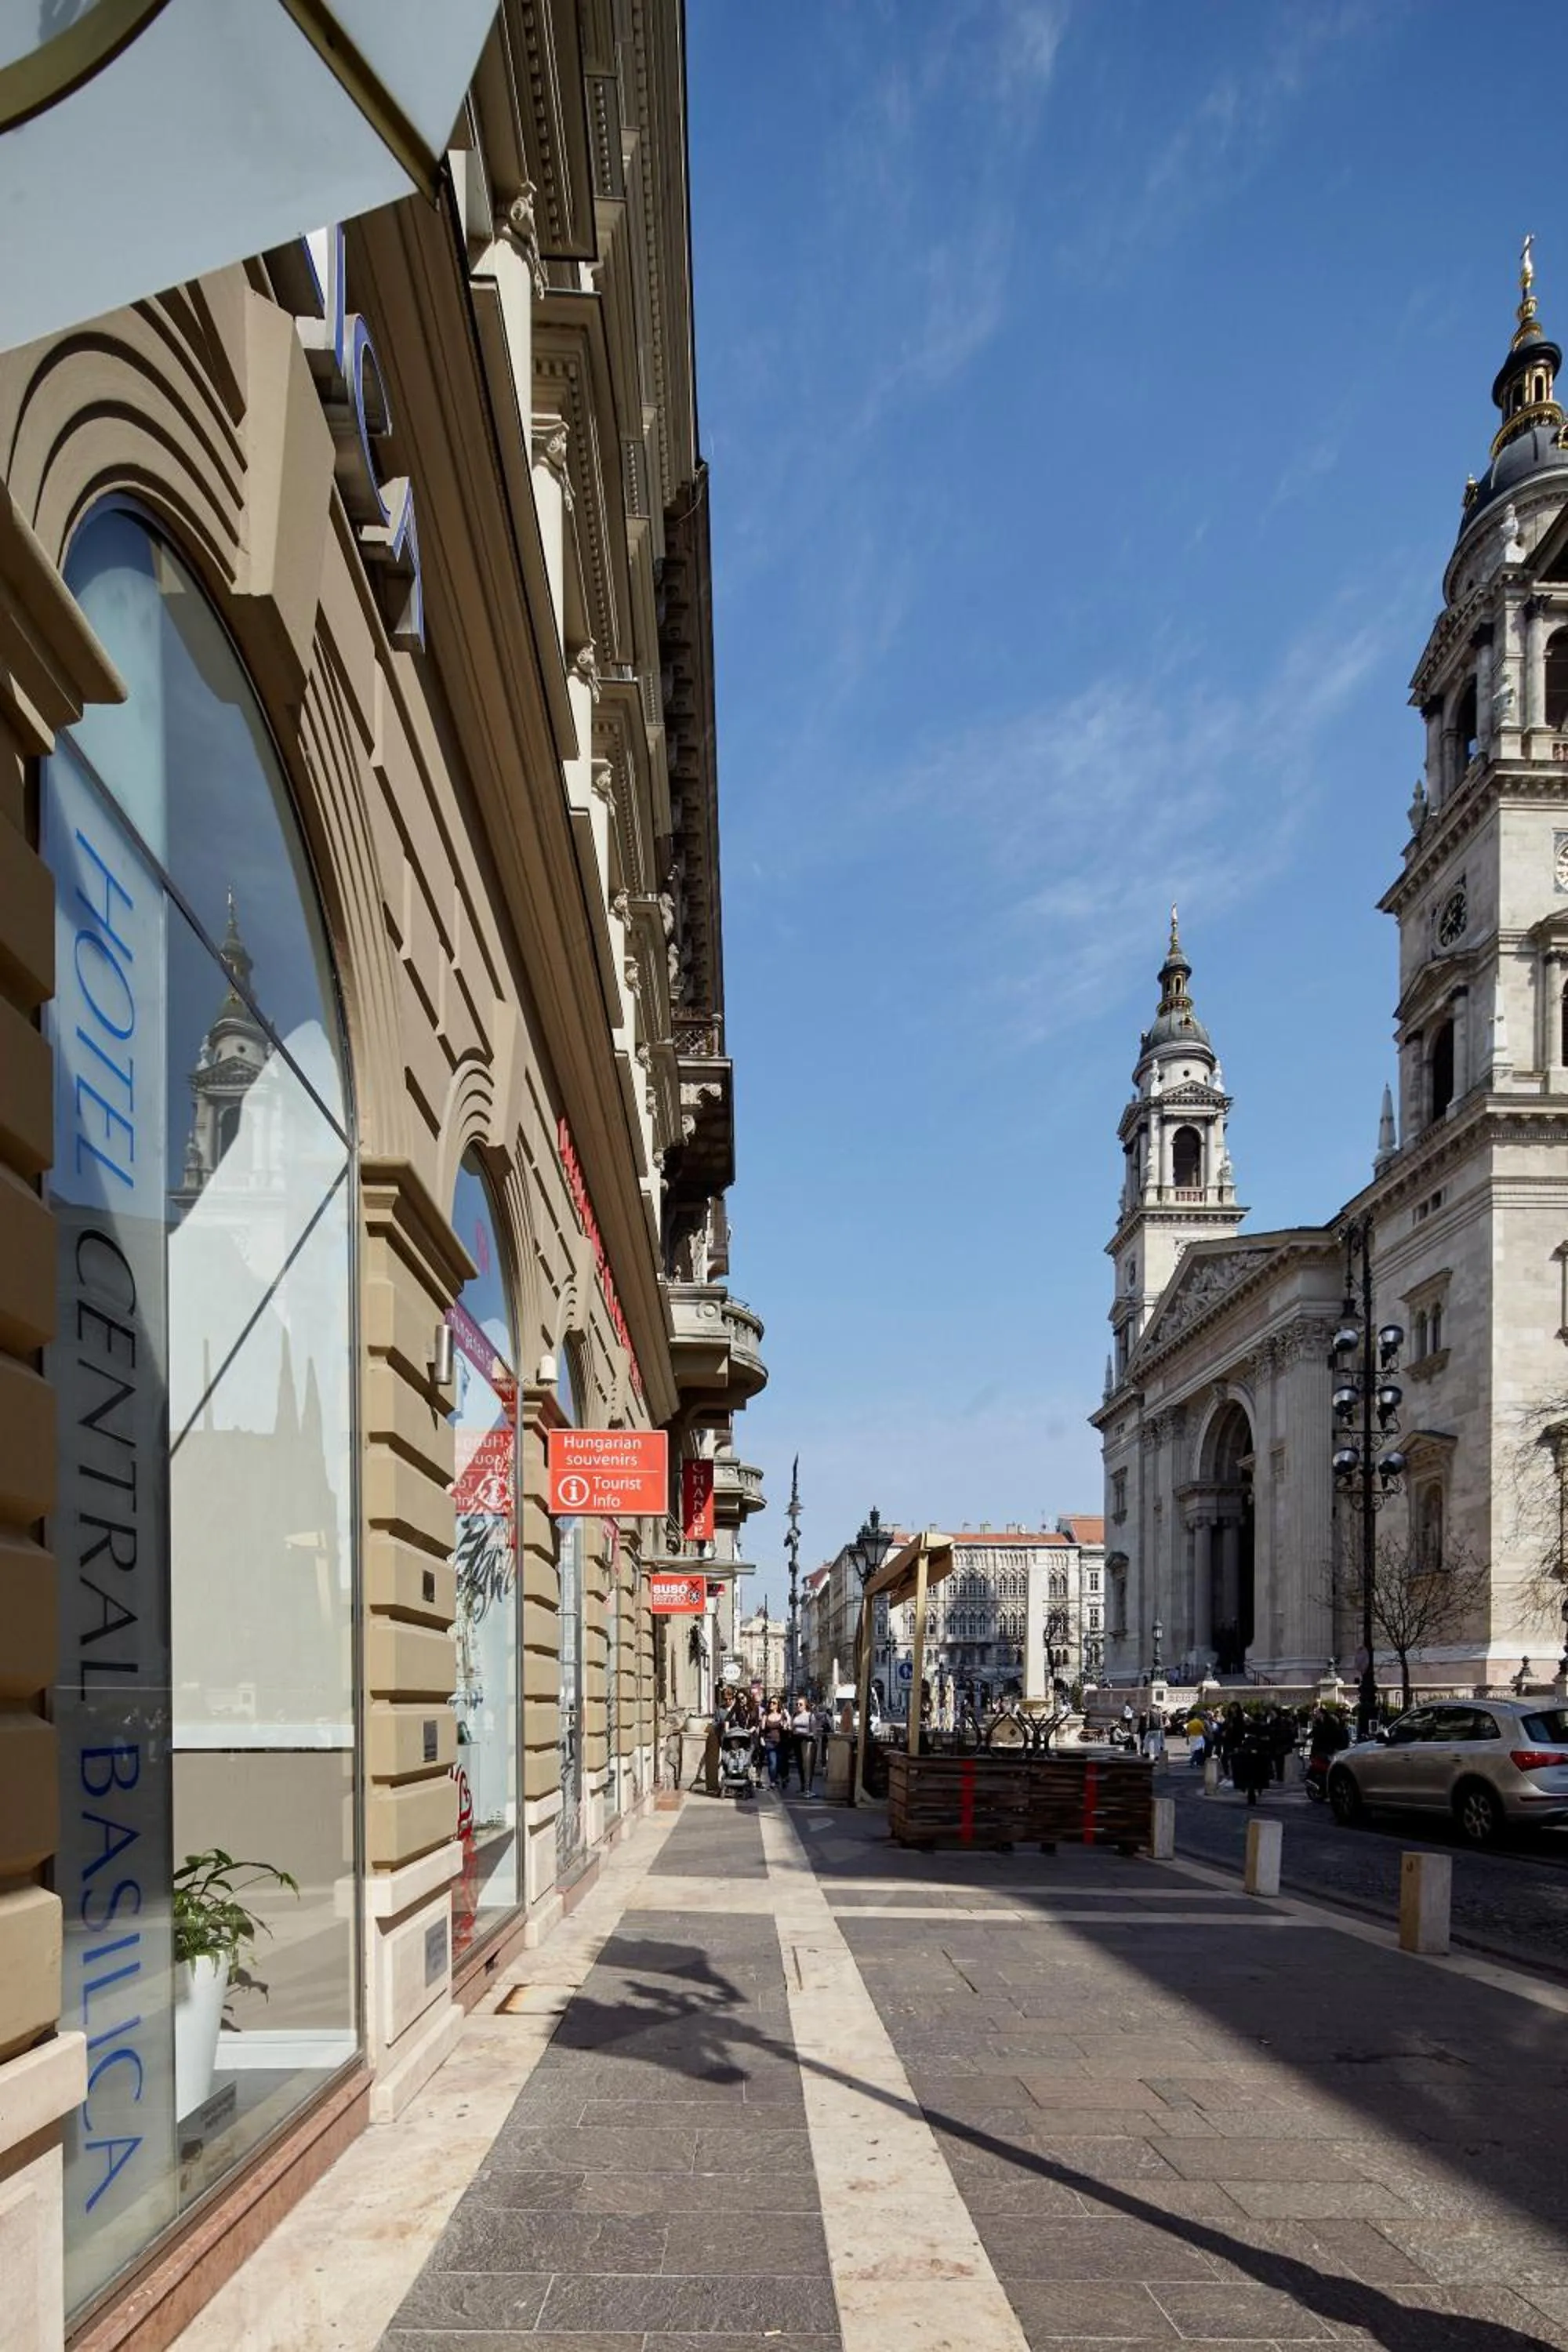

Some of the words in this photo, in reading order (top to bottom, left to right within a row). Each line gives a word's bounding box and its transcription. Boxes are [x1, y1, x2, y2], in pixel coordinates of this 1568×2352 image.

[75, 827, 135, 1189] HOTEL
[75, 1229, 139, 1702] CENTRAL
[563, 1436, 642, 1452] Hungarian
[565, 1454, 638, 1466] souvenirs
[592, 1475, 642, 1490] Tourist
[593, 1494, 621, 1508] Info
[691, 1461, 706, 1537] CHANGE
[81, 1744, 143, 2214] BASILICA
